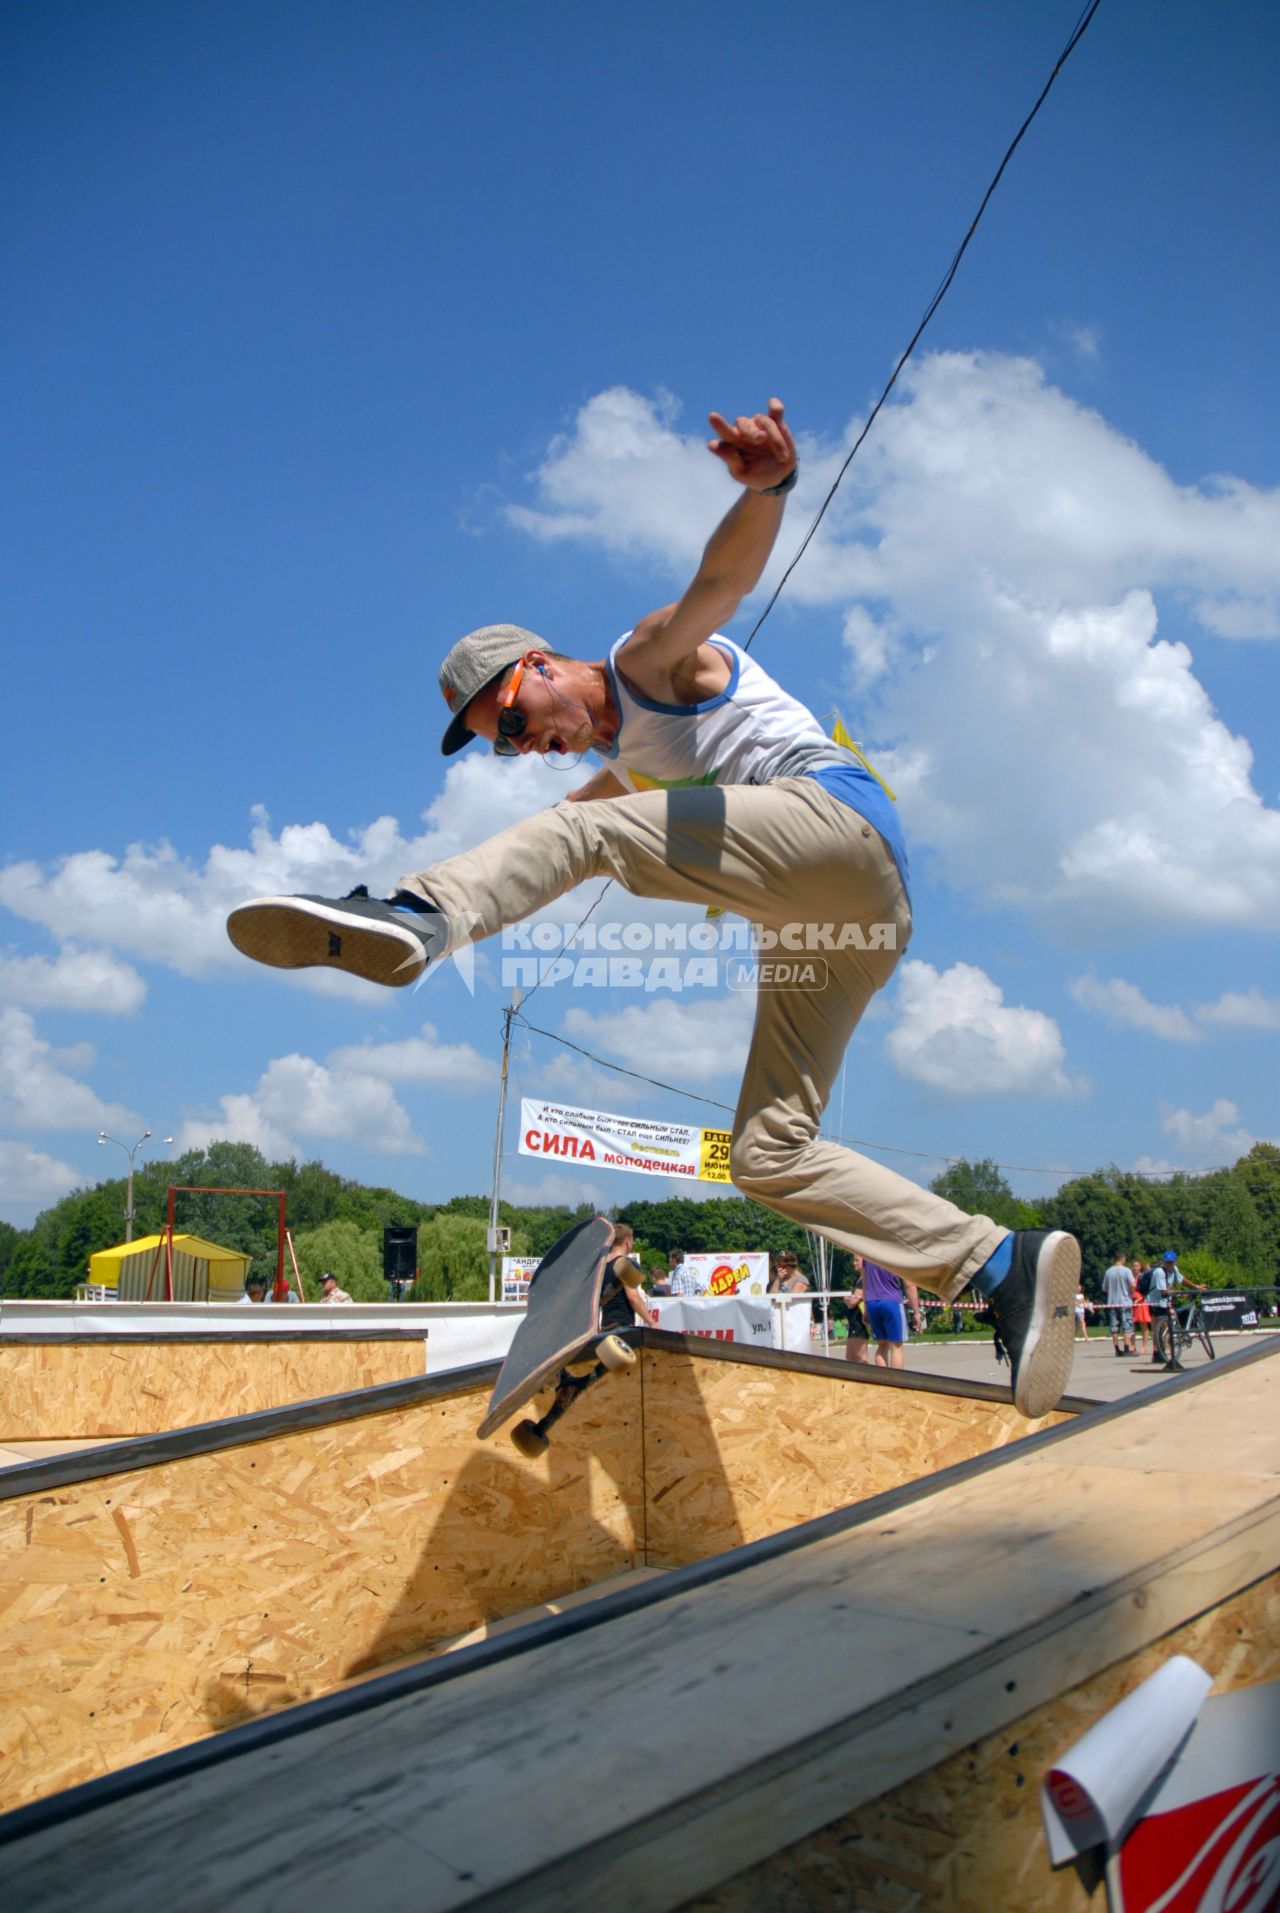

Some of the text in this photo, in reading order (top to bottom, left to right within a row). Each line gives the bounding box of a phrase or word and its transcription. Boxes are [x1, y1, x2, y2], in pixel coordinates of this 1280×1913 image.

[544, 1116, 558, 1124] кто
[559, 1120, 594, 1130] сильным
[596, 1124, 611, 1133] был
[617, 1128, 637, 1137] СТАЛ
[565, 1110, 595, 1121] слабым
[596, 1116, 611, 1124] был
[630, 1121, 668, 1133] СИЛЬНЫМ
[525, 1129, 696, 1176] СИЛА молодецкая
[708, 1144, 729, 1161] 29
[706, 1171, 727, 1180] 12.00
